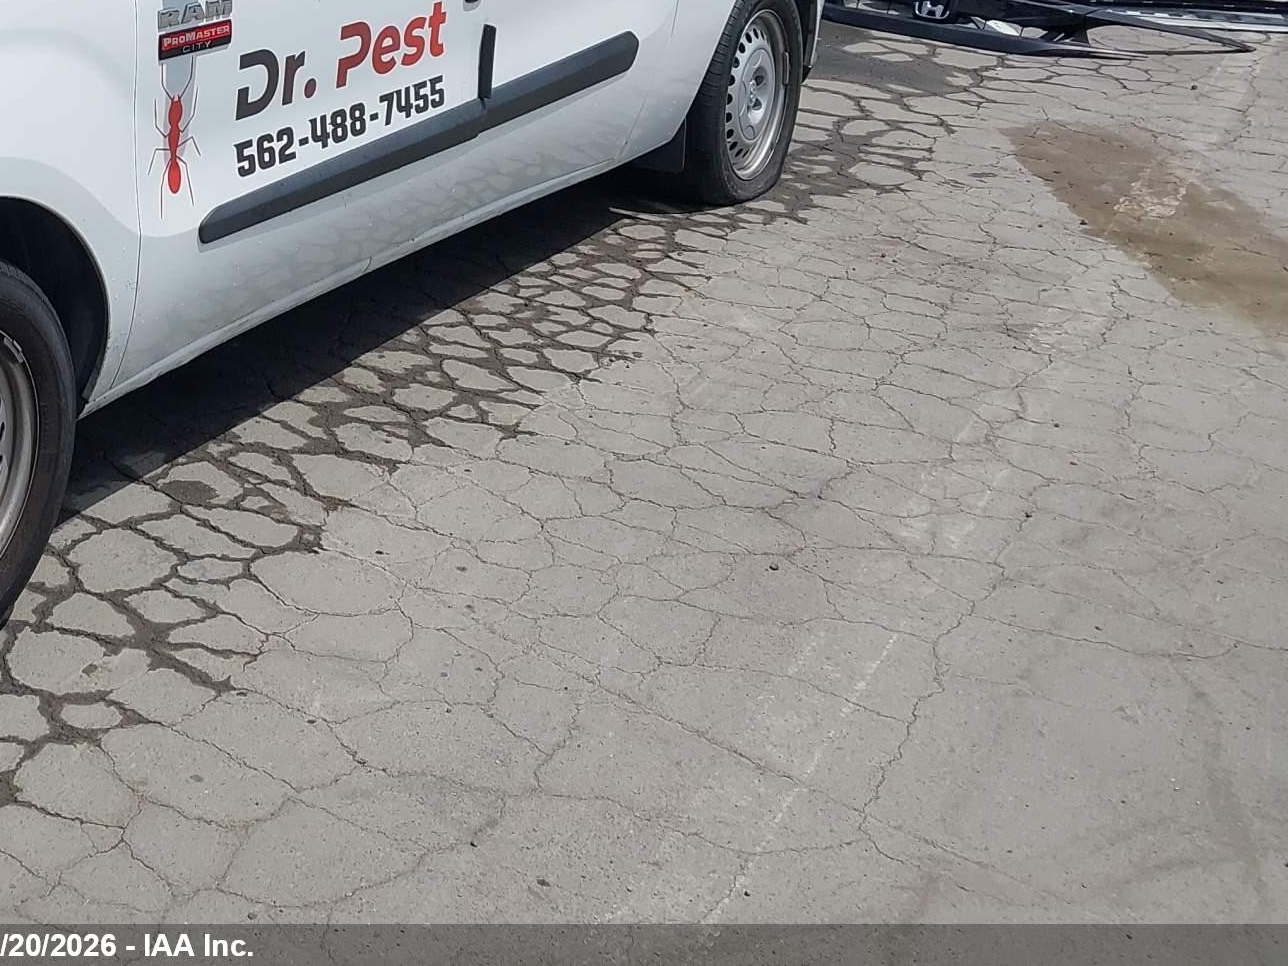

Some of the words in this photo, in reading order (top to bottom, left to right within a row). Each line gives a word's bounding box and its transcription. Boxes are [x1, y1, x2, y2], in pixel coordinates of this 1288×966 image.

[183, 40, 212, 53] CITY
[235, 48, 317, 121] Dr.
[336, 1, 447, 89] Pest
[233, 75, 445, 177] 562-488-7455
